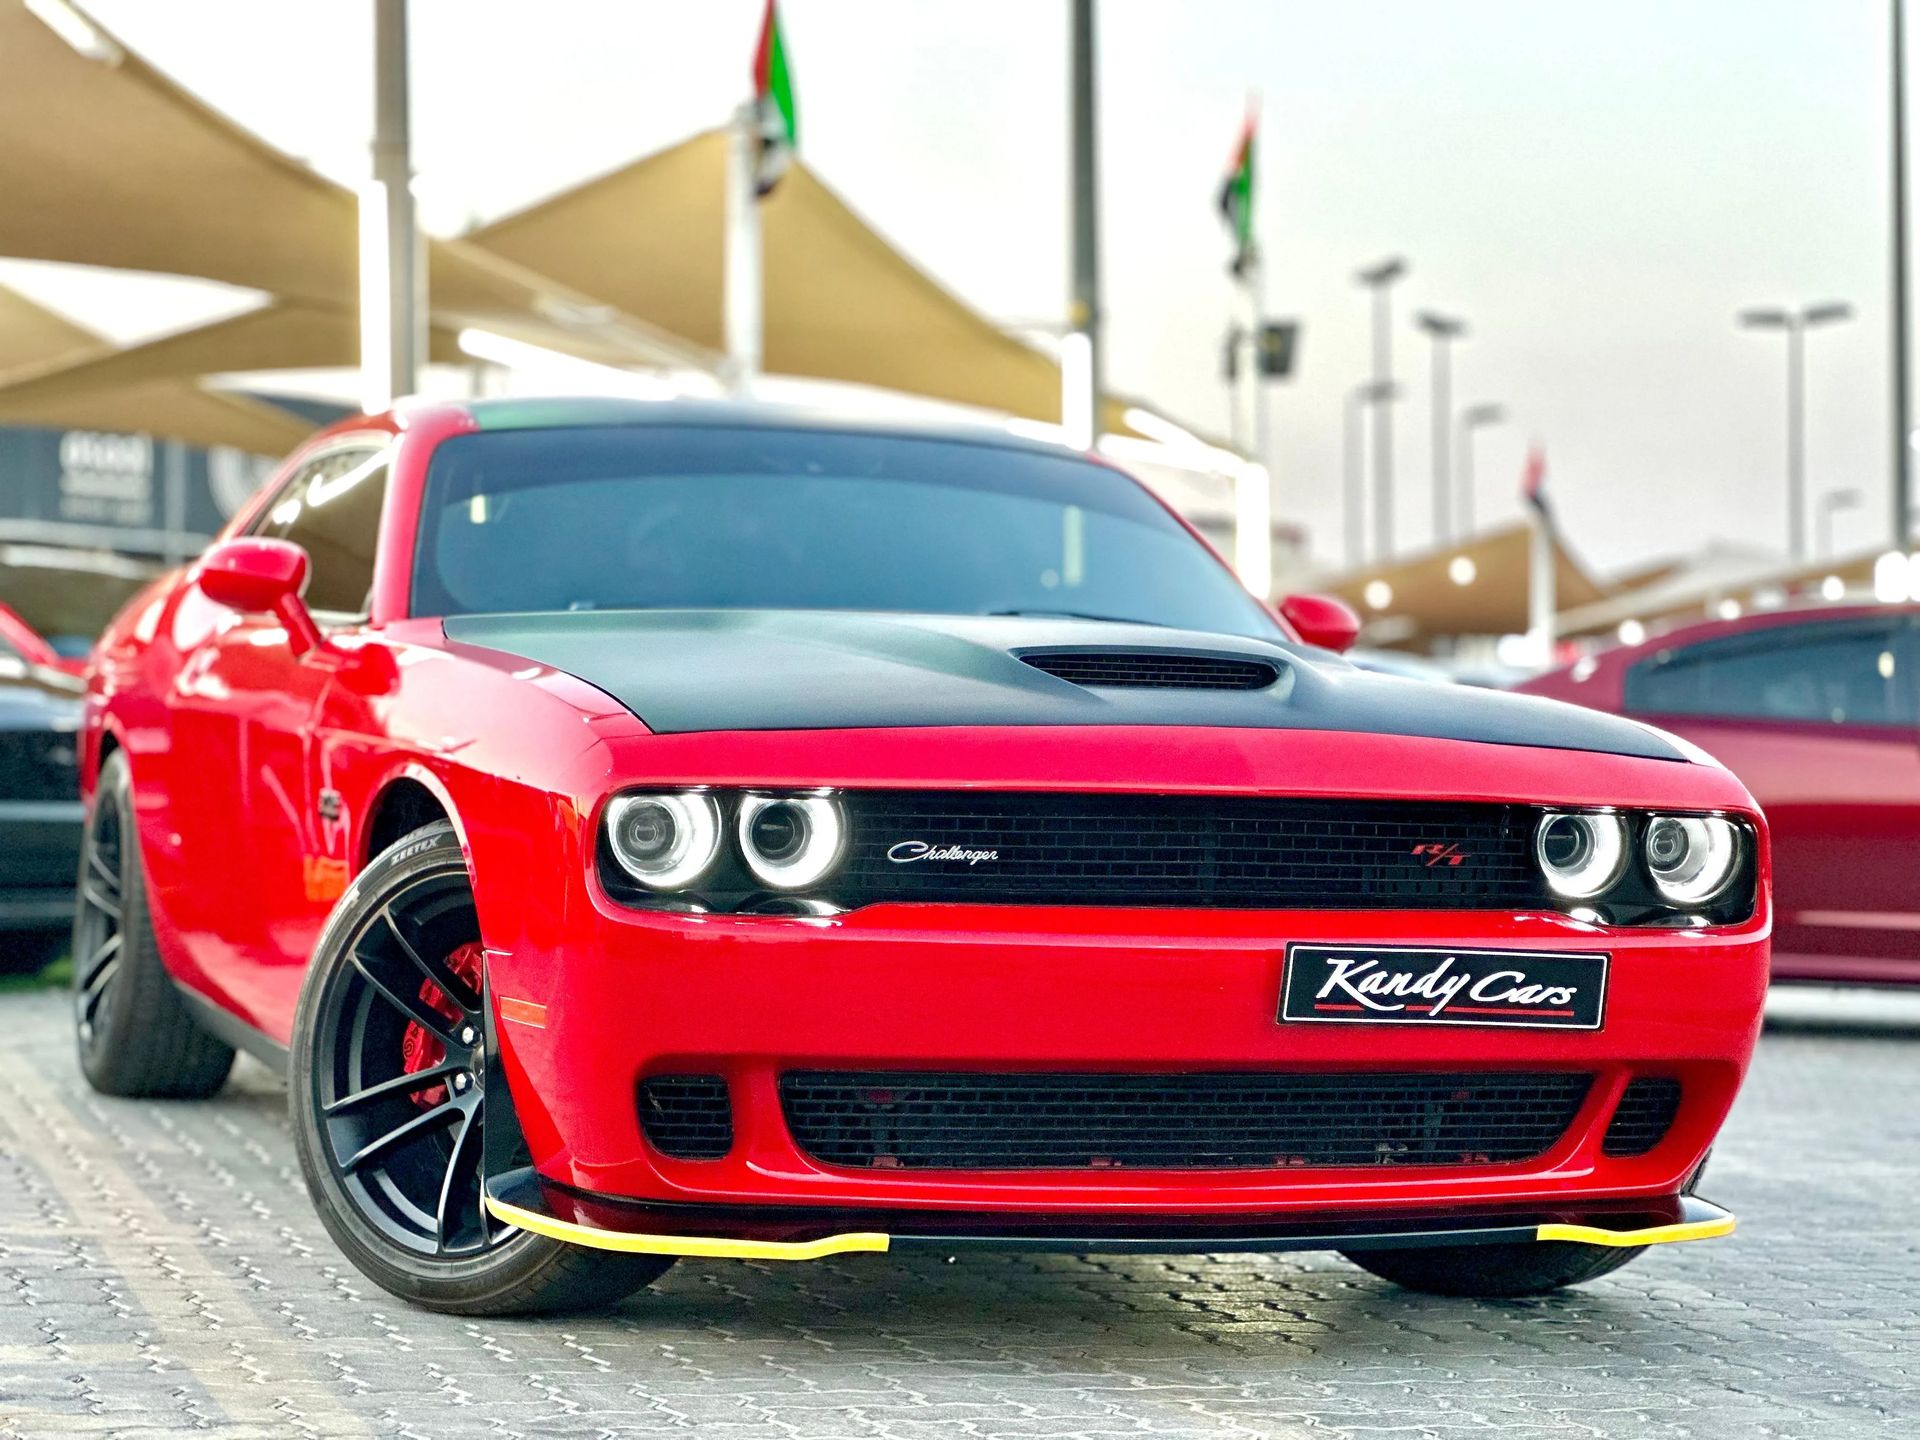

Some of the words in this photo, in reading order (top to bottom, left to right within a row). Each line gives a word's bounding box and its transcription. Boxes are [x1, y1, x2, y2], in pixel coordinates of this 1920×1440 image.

[887, 840, 999, 866] Challenger
[1316, 957, 1469, 1017] Kandy
[1469, 971, 1577, 1005] Cars
